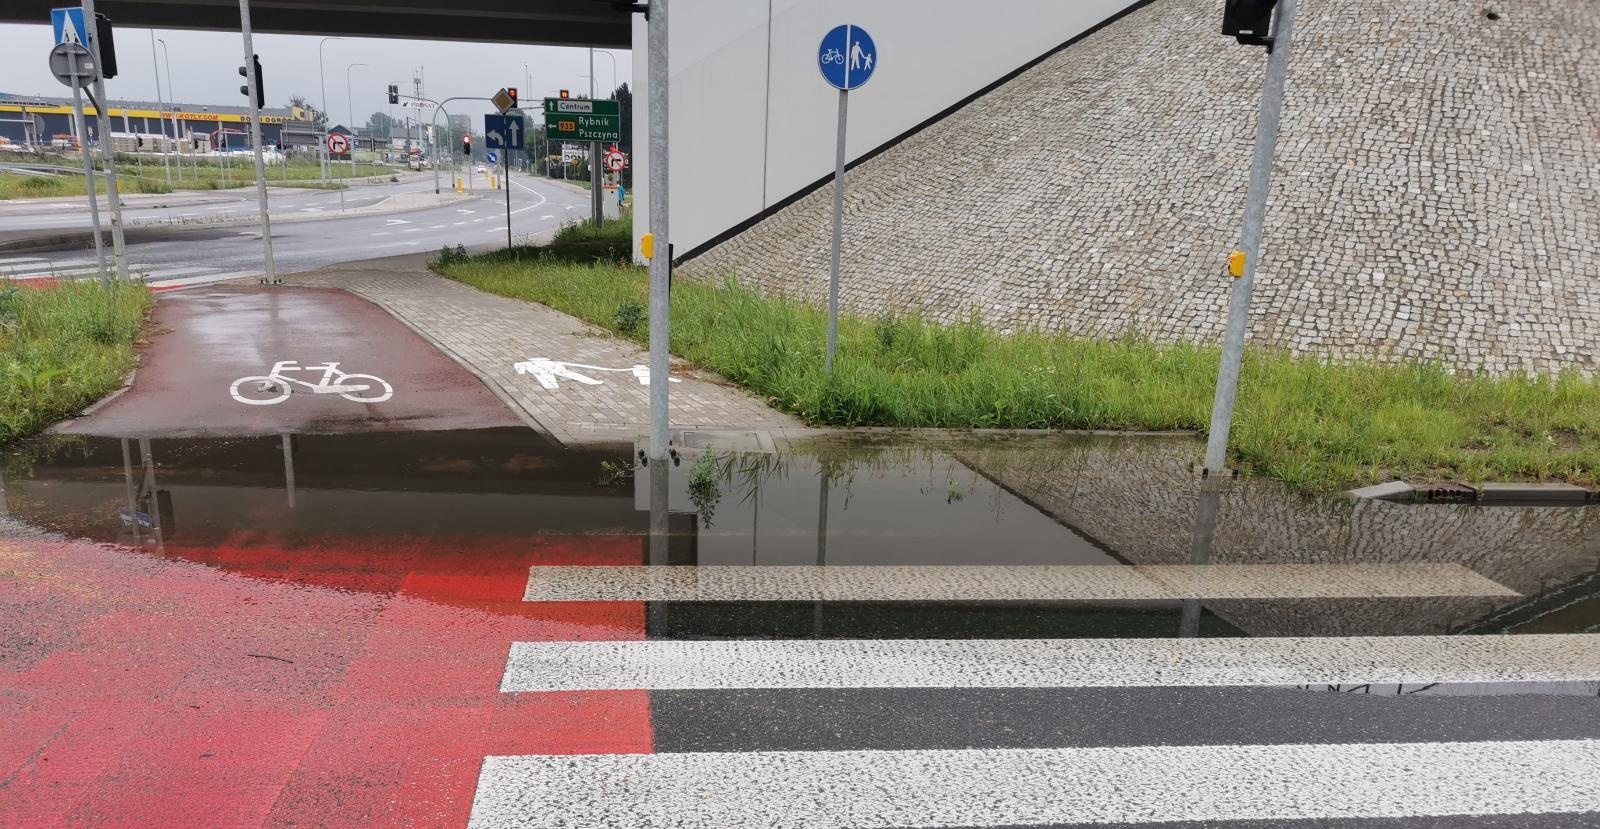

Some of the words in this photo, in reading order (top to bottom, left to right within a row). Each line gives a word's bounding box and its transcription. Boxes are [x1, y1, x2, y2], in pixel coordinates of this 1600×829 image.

[560, 102, 590, 110] Centrum
[560, 122, 573, 130] 935
[579, 116, 609, 127] Rybnik
[579, 129, 618, 140] Pszczyna
